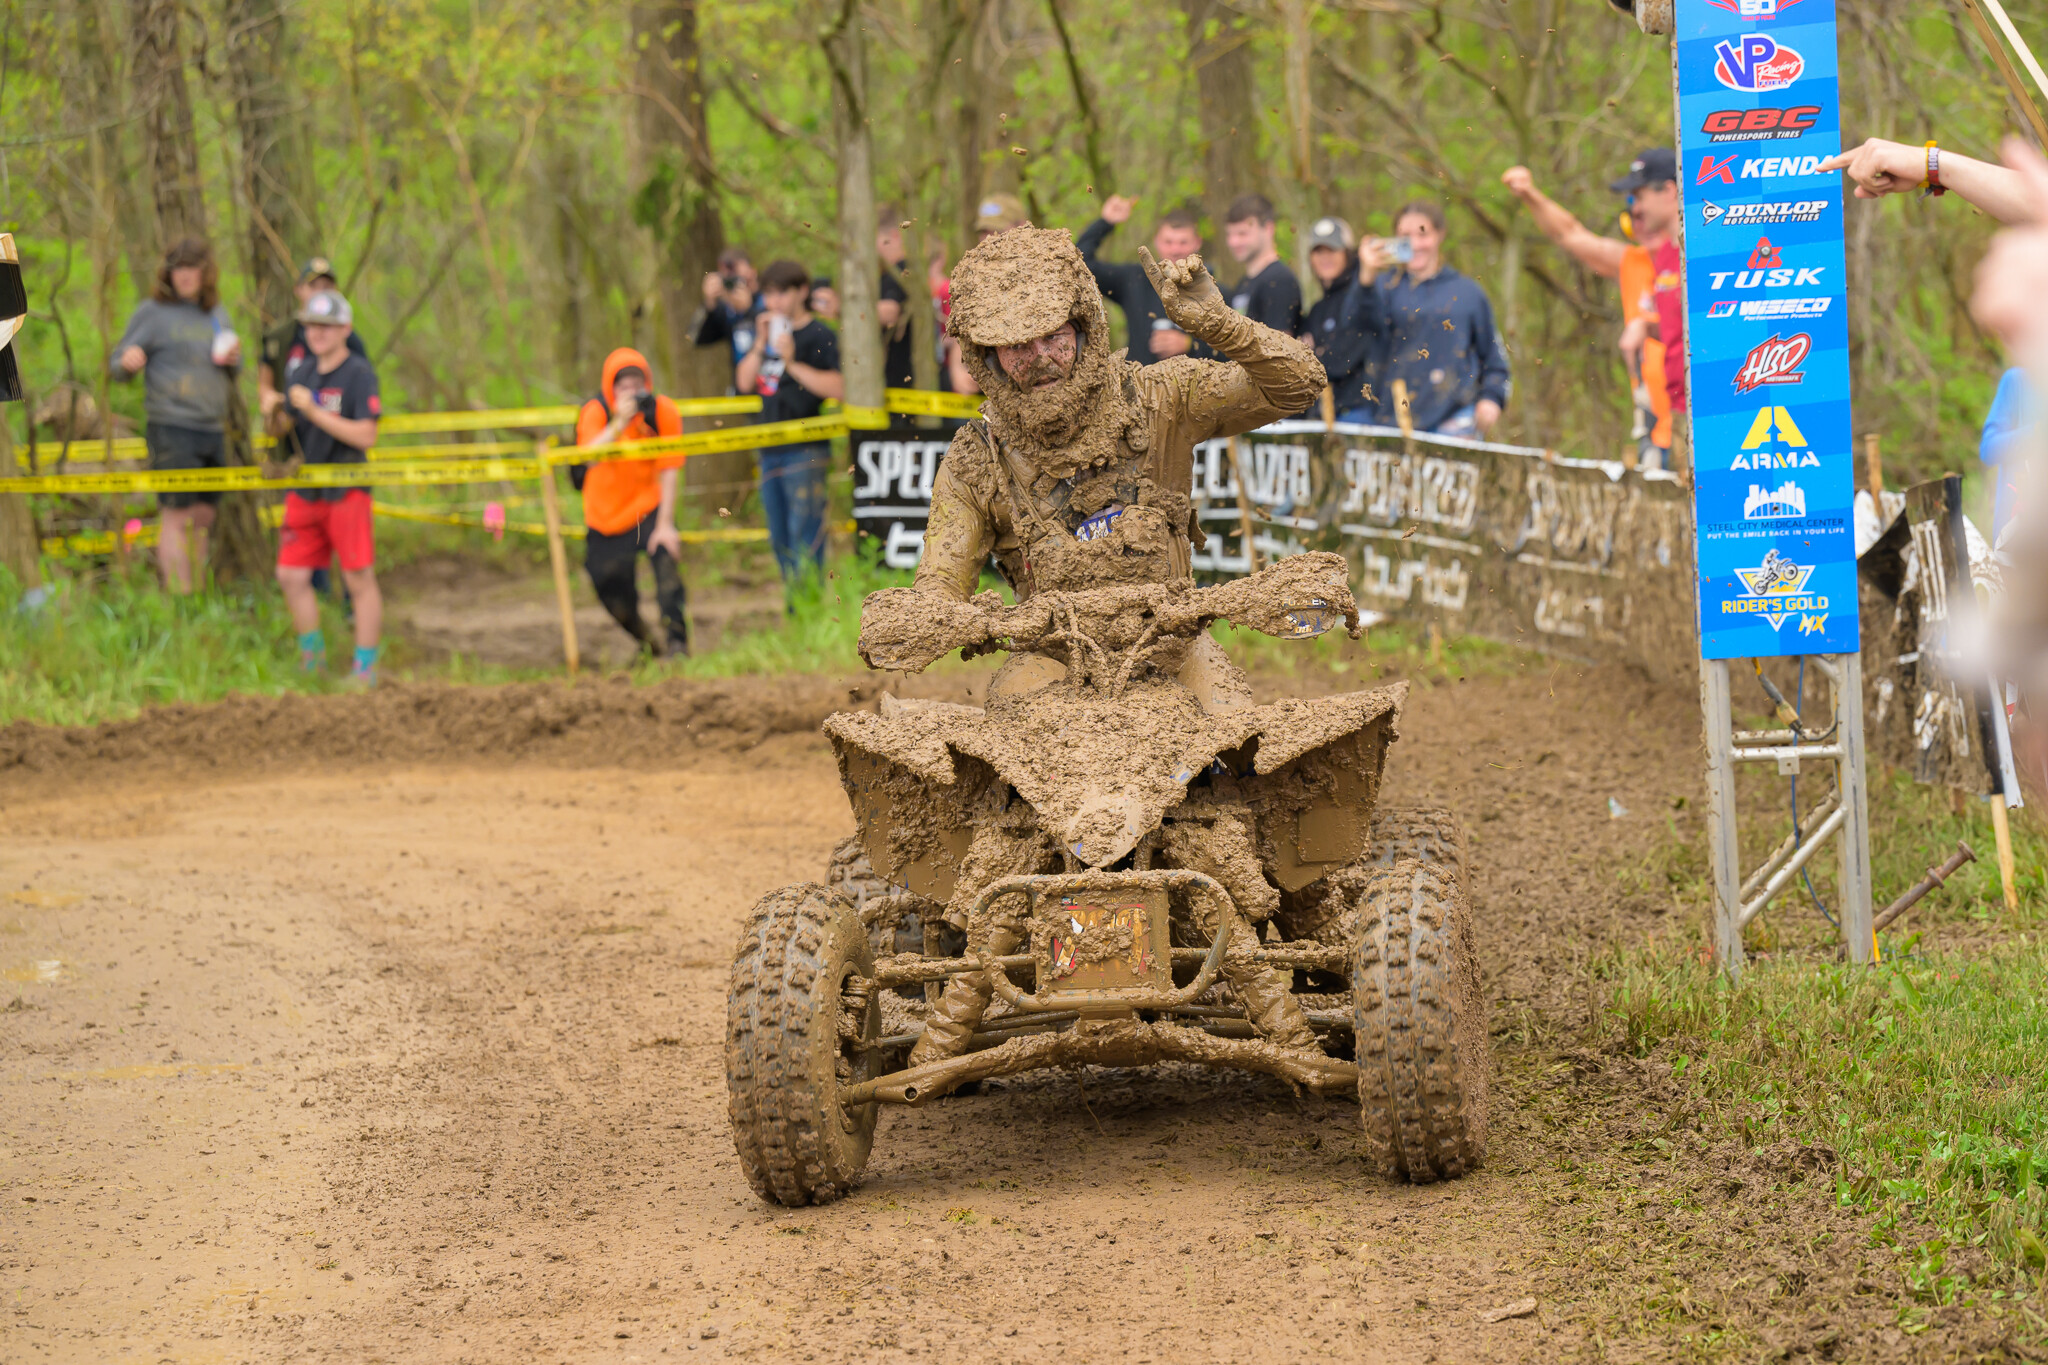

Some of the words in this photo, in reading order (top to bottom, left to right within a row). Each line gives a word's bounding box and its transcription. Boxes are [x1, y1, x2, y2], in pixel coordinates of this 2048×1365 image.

[1716, 36, 1776, 88] VP
[1757, 60, 1804, 79] Racing
[1759, 78, 1788, 86] FUELS
[1703, 106, 1821, 132] GBC
[1712, 131, 1773, 142] POWERSPORTS
[1776, 130, 1800, 138] TIRES
[1725, 200, 1829, 218] DUNLOP
[1722, 214, 1786, 225] MOTORCYCLE
[1791, 212, 1820, 222] TIRES
[1709, 267, 1826, 290] TUSK
[1790, 312, 1823, 320] Products
[1730, 451, 1821, 471] ARMA
[1707, 523, 1734, 531] STEEL
[1737, 522, 1758, 530] CITY
[1761, 520, 1804, 529] MEDICAL
[1806, 518, 1844, 527] CENTER
[1721, 598, 1782, 613] RIDER'S
[1785, 596, 1829, 610] GOLD
[1798, 612, 1830, 637] MX
